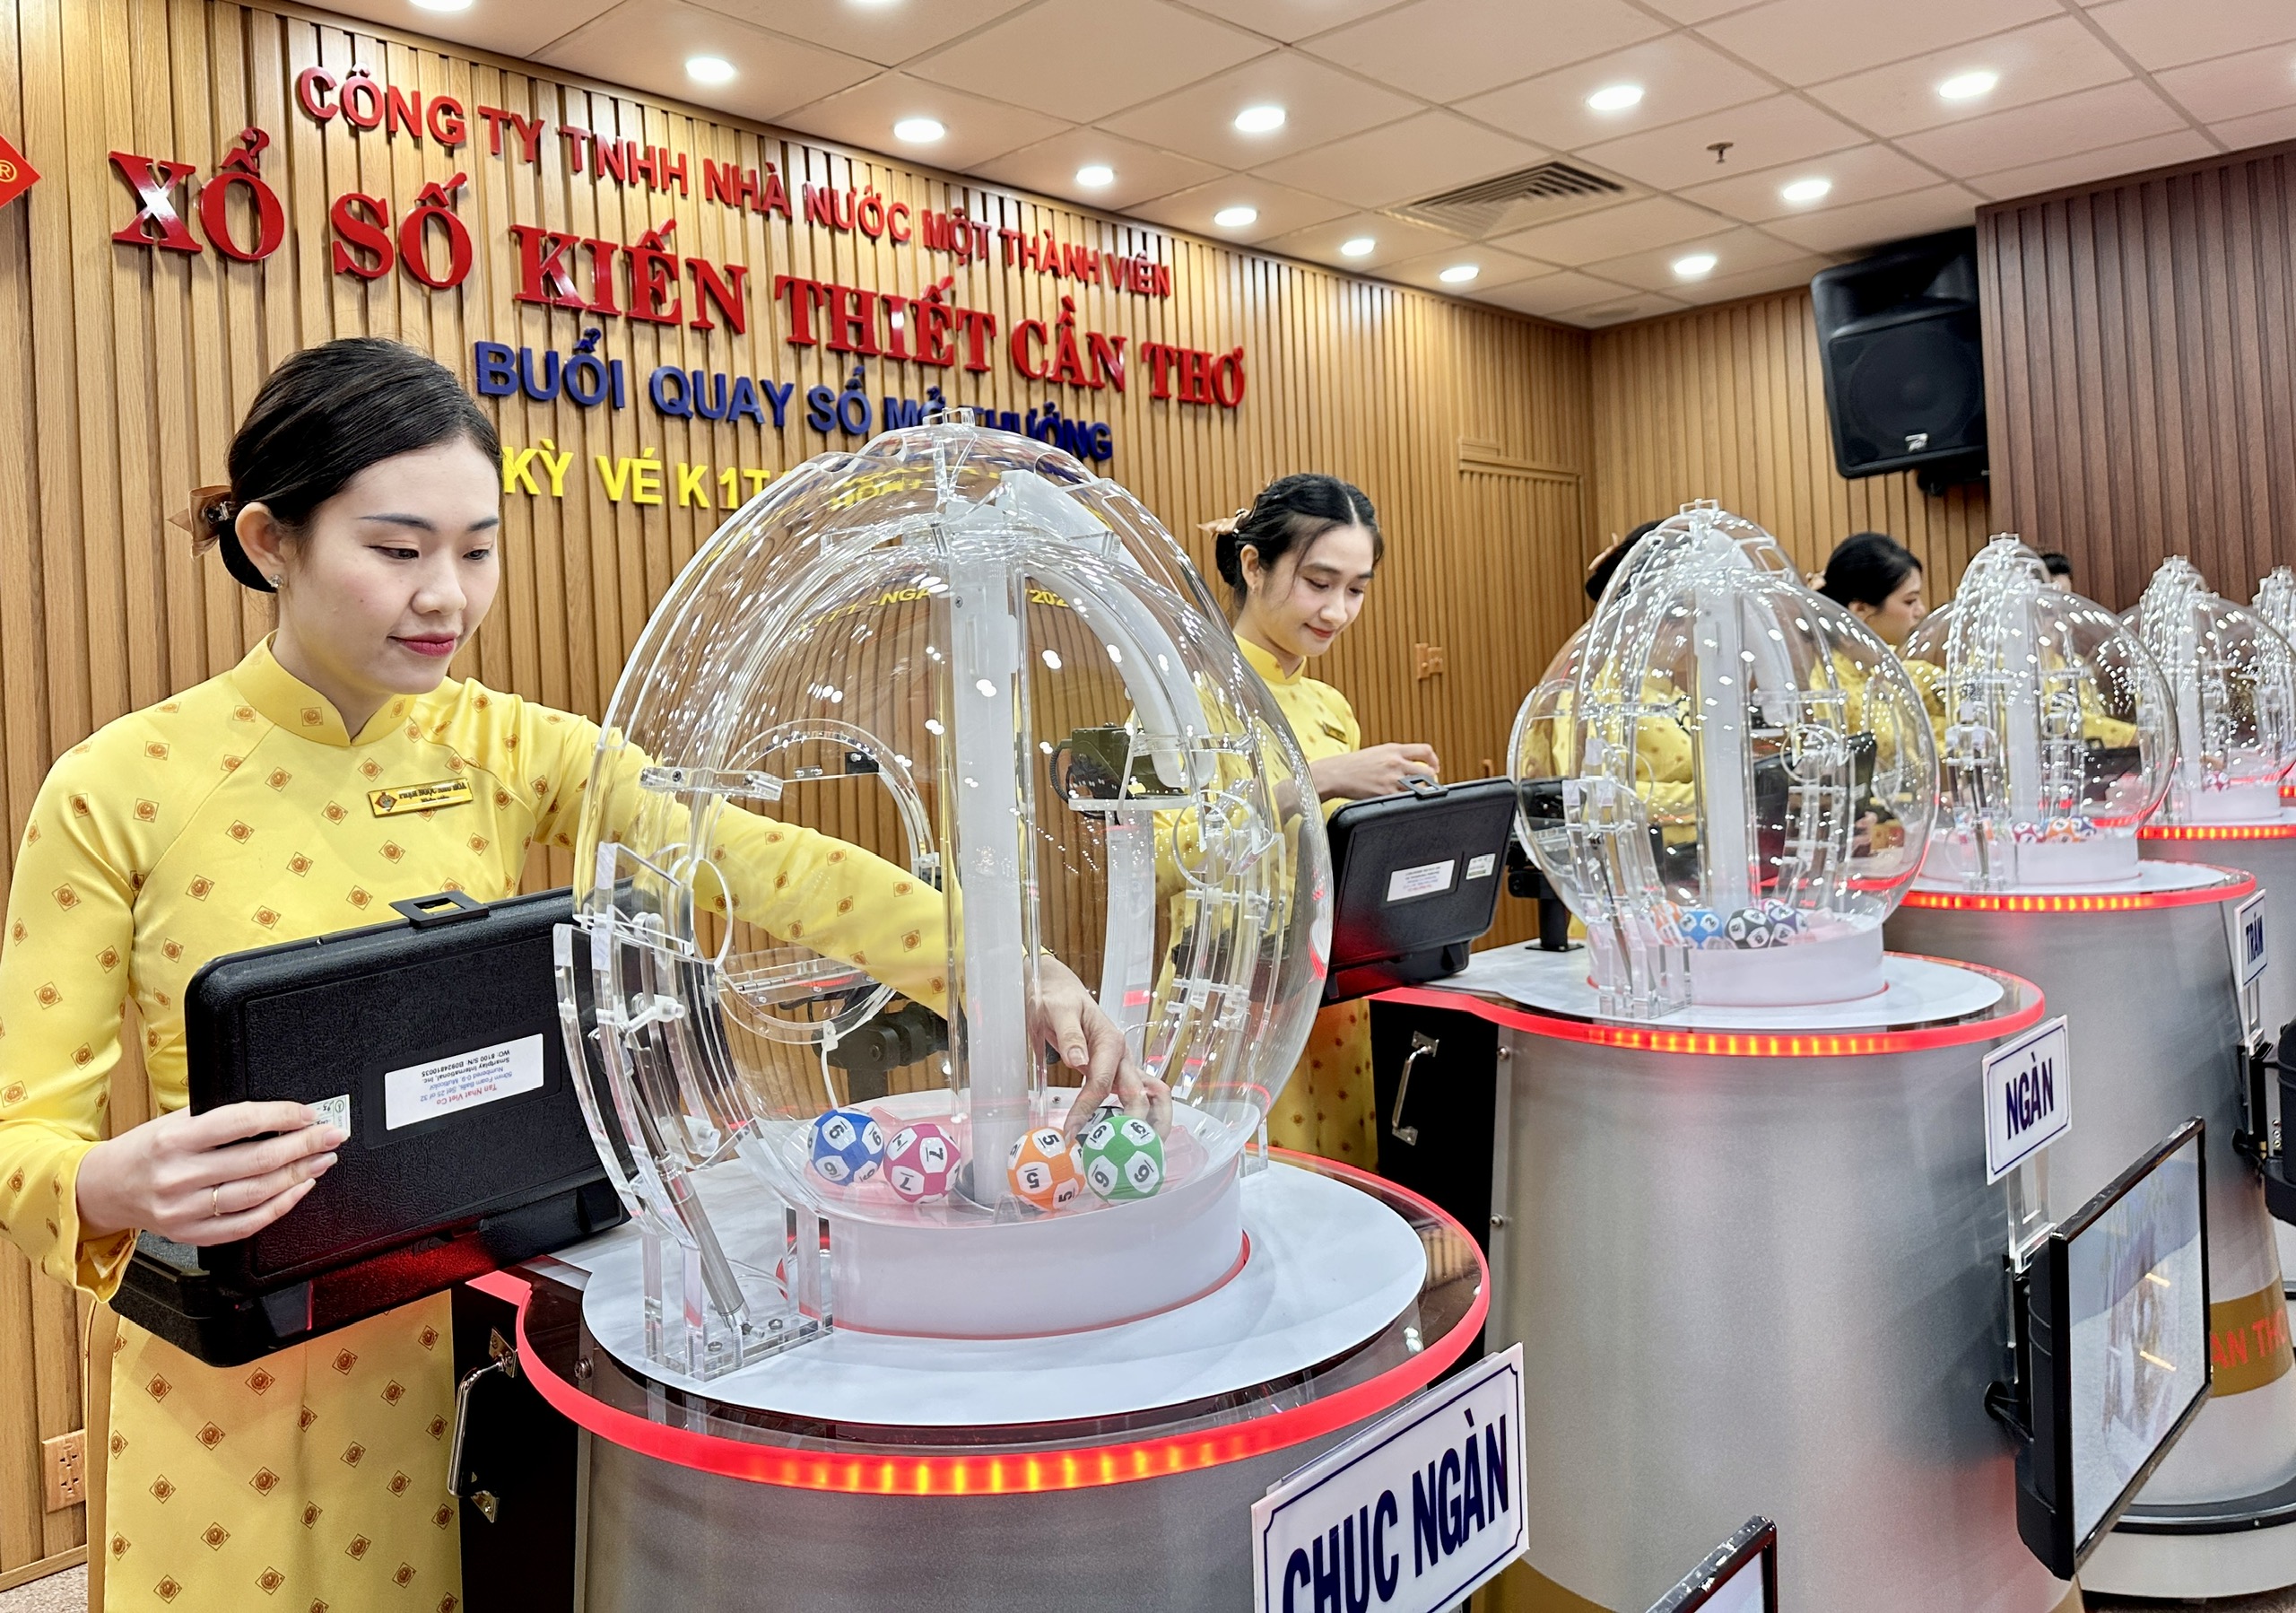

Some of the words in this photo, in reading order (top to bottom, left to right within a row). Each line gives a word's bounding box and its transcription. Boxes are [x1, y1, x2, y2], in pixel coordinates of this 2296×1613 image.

[300, 62, 466, 144] CÔNG
[477, 105, 545, 162] TY
[560, 125, 688, 195] TNHH
[703, 162, 792, 217] NHÀ
[804, 180, 910, 242] NƯỚC
[921, 207, 991, 266] MỘT
[998, 230, 1100, 285] THÀNH
[1107, 250, 1170, 297] VIÊN
[108, 127, 285, 262] XỔ
[331, 172, 473, 290] SỐ
[509, 218, 748, 335] KIẾN
[775, 275, 996, 372] THIẾT
[1012, 295, 1127, 392] CẦN
[1142, 342, 1245, 408] THƠ
[474, 327, 626, 409] BUỔI
[649, 365, 794, 428] QUAY
[807, 365, 872, 435] SỐ
[502, 439, 574, 497] KỲ
[596, 448, 663, 505] VÉ
[677, 463, 791, 510] K1T
[478, 1057, 510, 1068] Smartplay
[475, 1076, 492, 1086] Foam
[465, 1087, 483, 1097] Nhat
[484, 1084, 497, 1094] Tan
[2005, 1051, 2055, 1140] NGÀN
[1042, 1134, 1060, 1146] 5
[929, 1147, 944, 1161] 7
[899, 1176, 912, 1191] 7
[1026, 1172, 1040, 1190] 5
[1058, 1190, 1074, 1203] 5
[1413, 1408, 1509, 1578] NGÀN
